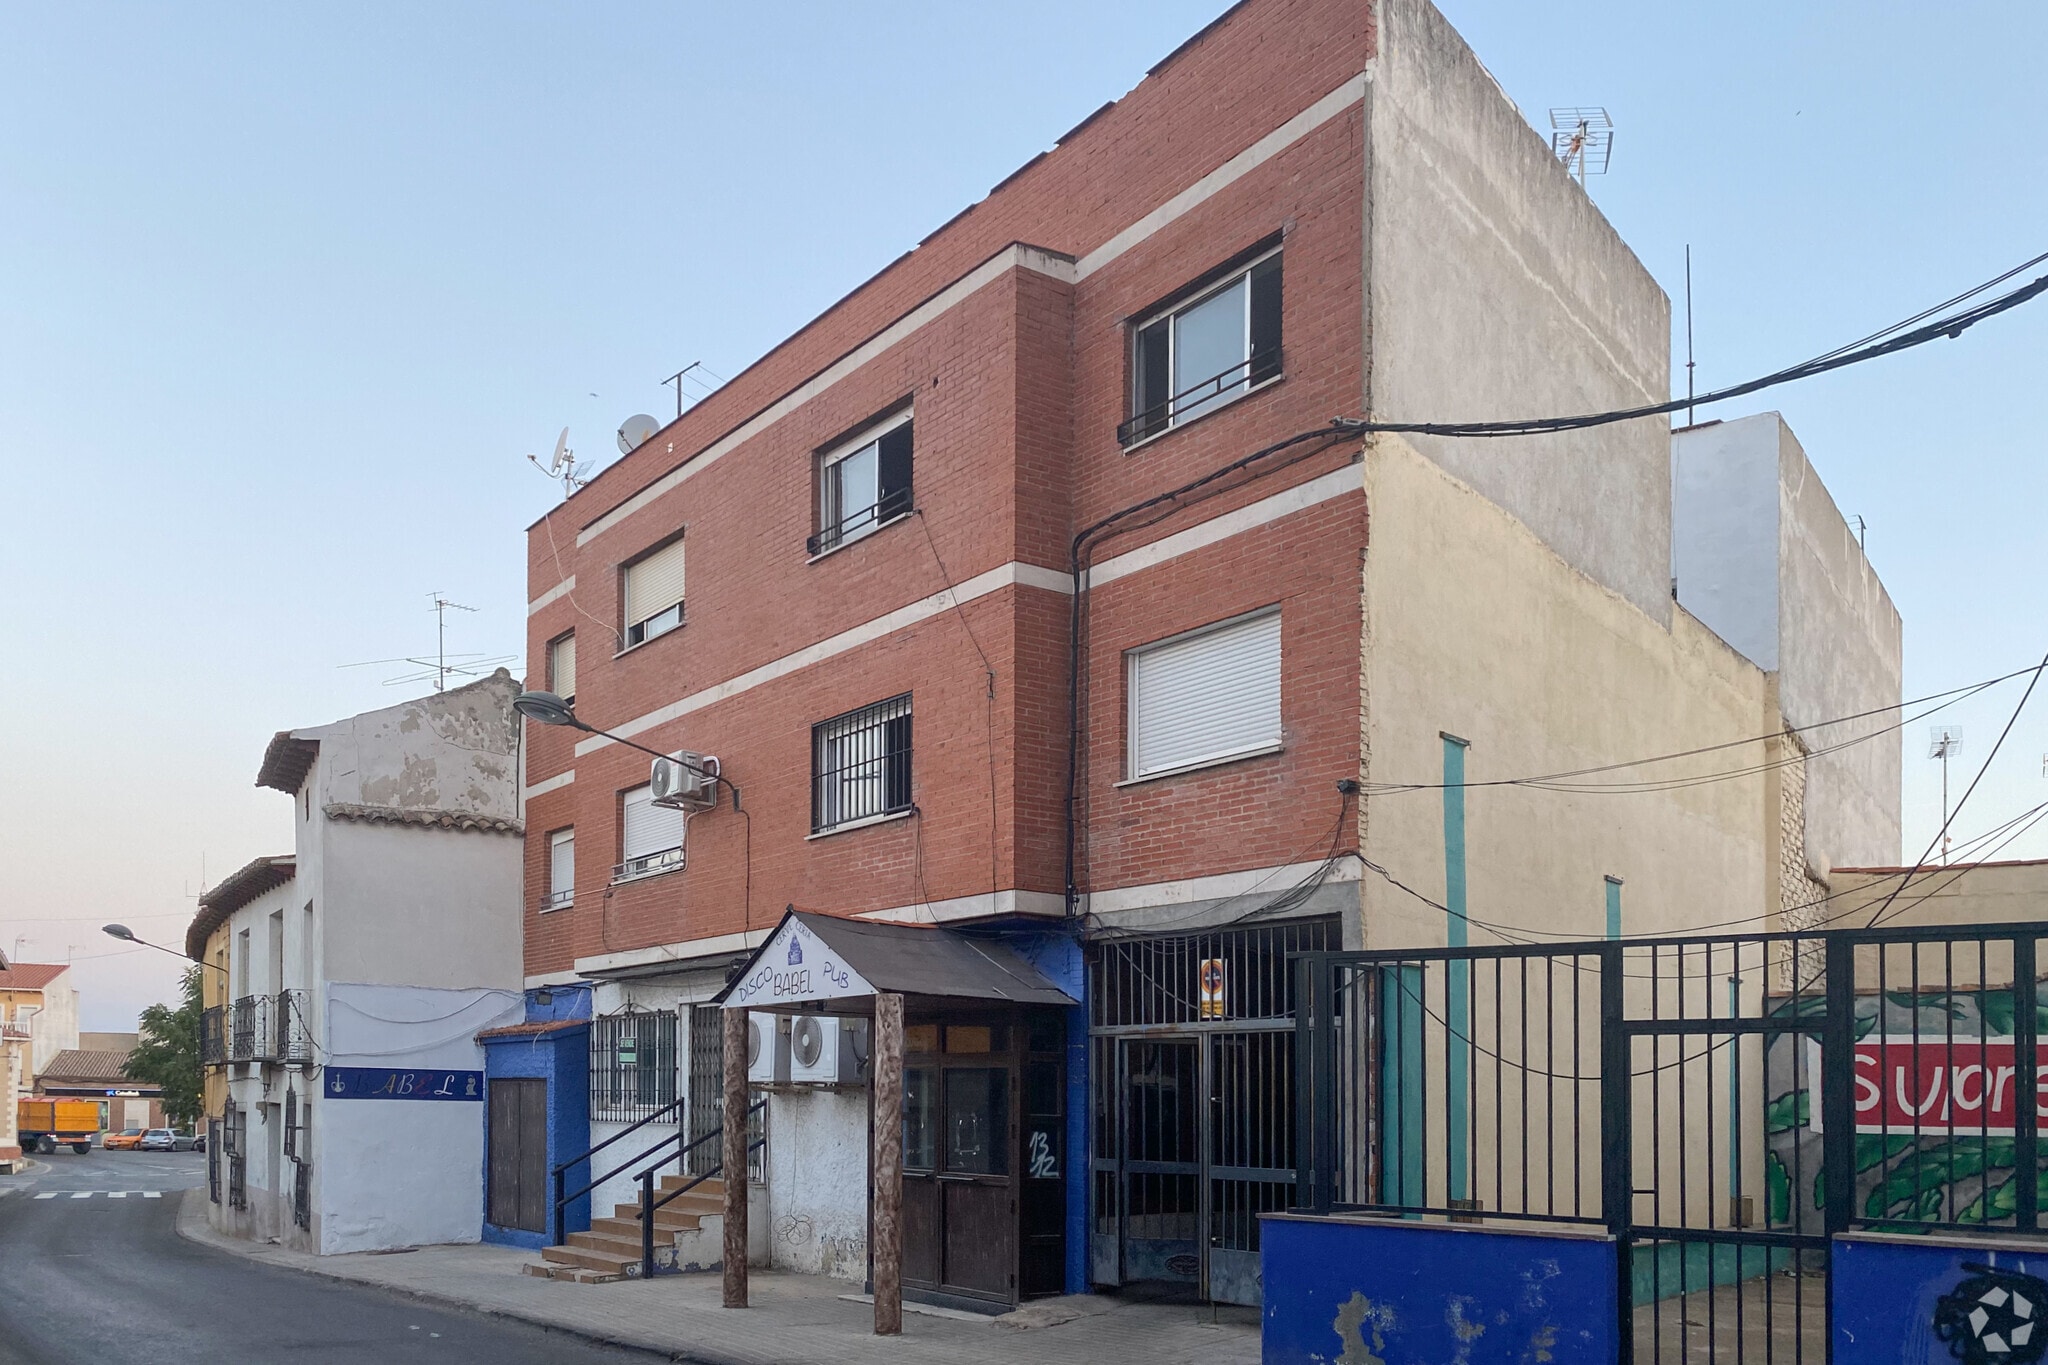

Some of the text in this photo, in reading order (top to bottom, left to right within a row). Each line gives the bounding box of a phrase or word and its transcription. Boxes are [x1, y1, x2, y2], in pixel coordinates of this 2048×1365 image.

[738, 961, 849, 1002] DISCO BABEL PUB
